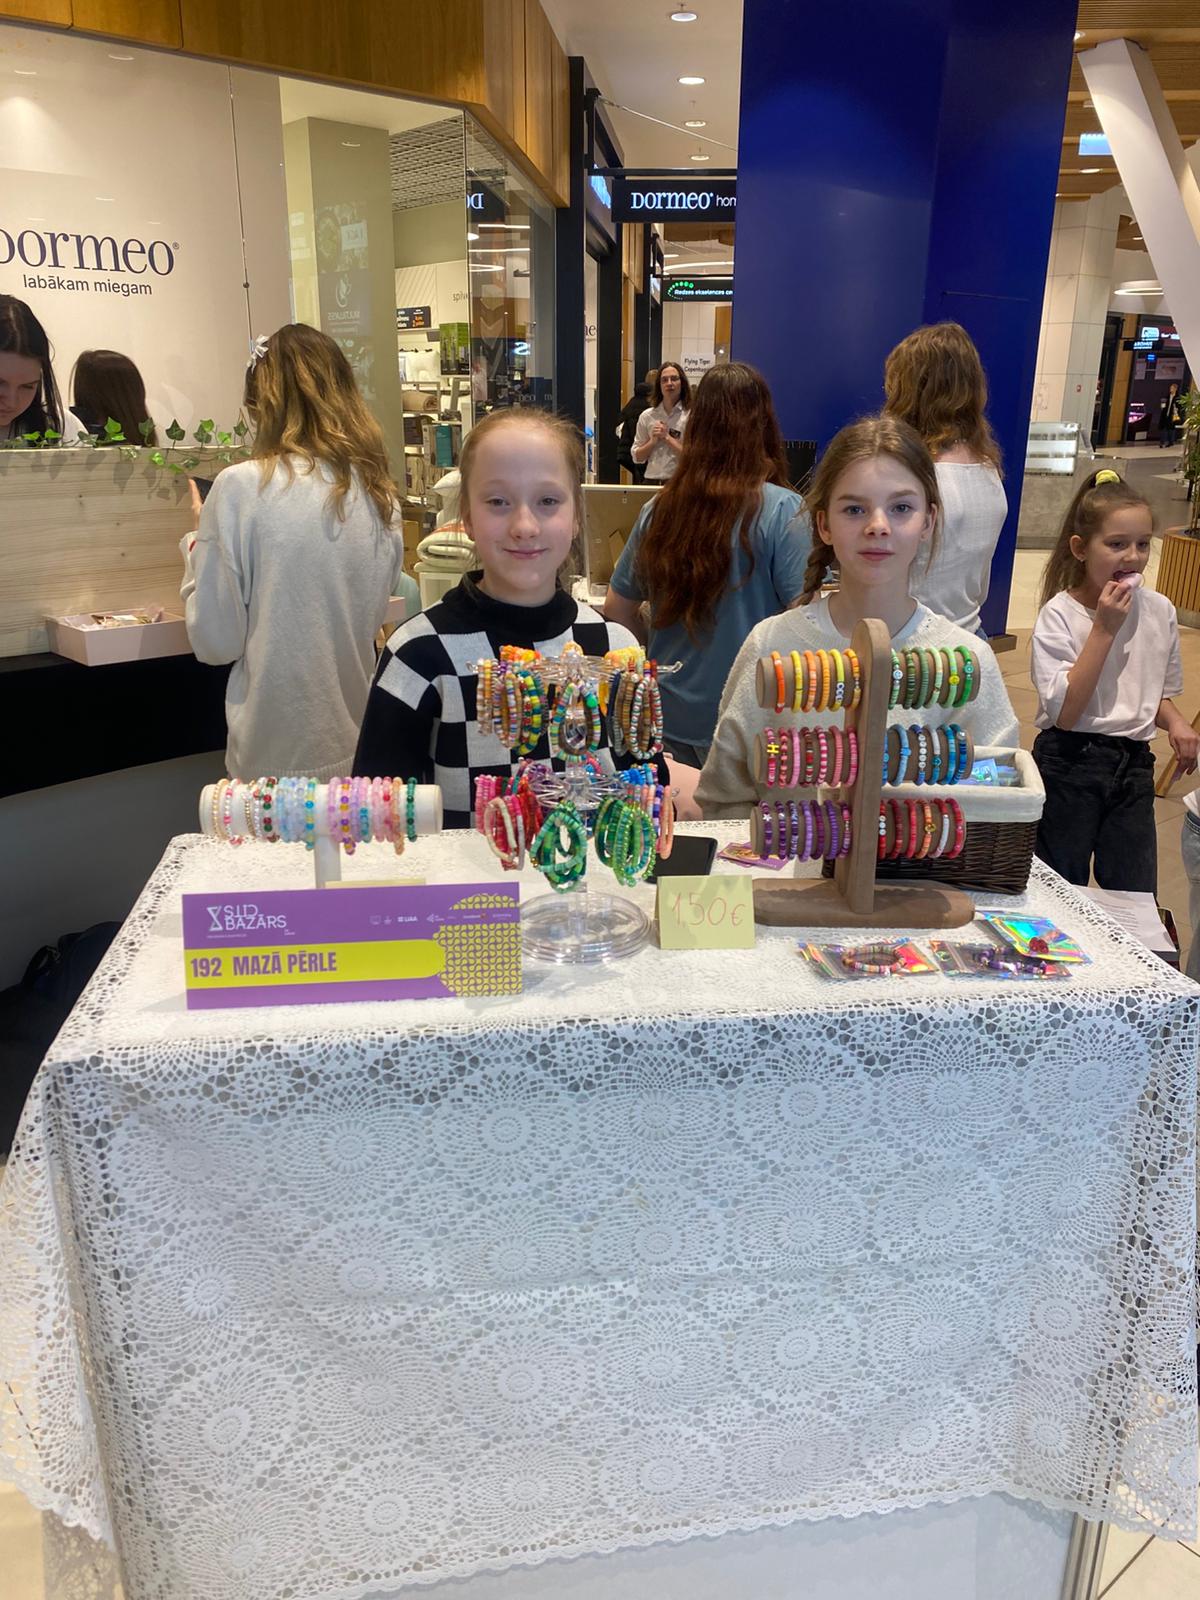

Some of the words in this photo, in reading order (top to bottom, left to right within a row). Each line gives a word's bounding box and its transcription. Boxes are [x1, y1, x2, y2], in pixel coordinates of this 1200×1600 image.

[23, 274, 90, 291] labākam
[94, 279, 153, 297] miegam
[190, 956, 222, 978] 192
[232, 951, 282, 976] MAZĀ
[287, 950, 337, 974] PĒRLE
